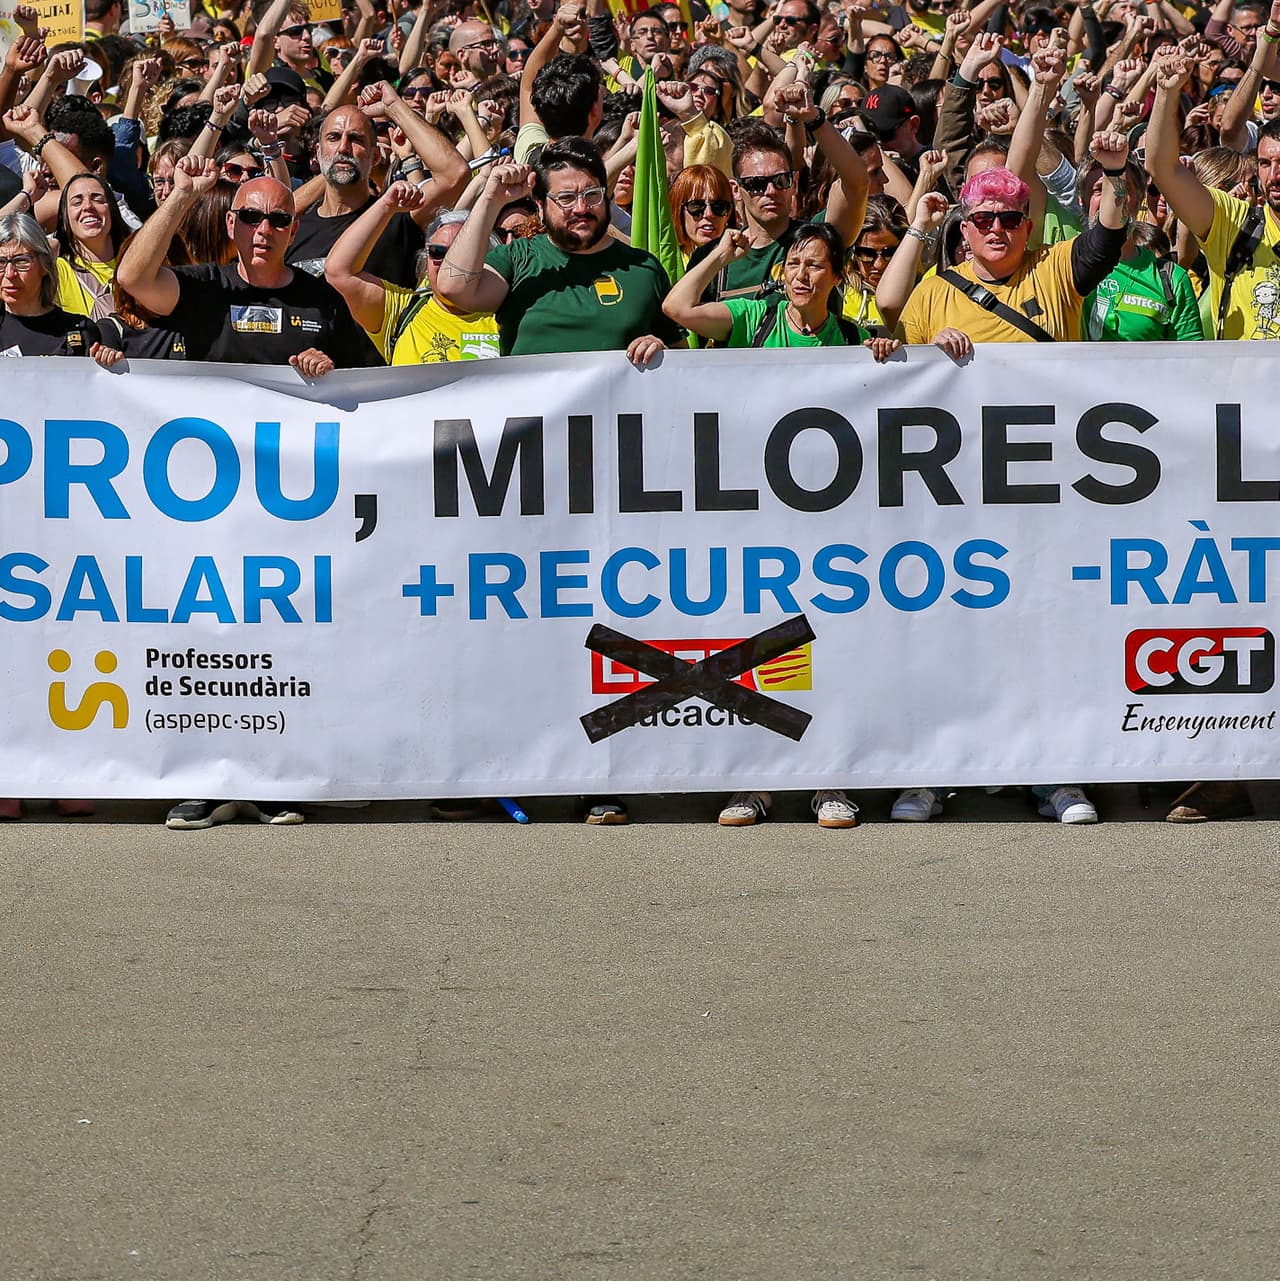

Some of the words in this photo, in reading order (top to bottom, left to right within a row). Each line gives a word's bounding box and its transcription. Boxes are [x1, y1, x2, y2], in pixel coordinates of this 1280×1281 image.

[434, 403, 1160, 518] MILLORES
[403, 539, 1010, 620] +RECURSOS
[146, 648, 273, 669] Professors
[1135, 638, 1266, 687] CGT
[145, 676, 173, 697] de
[179, 676, 311, 697] Secundària
[1121, 703, 1277, 739] Ensenyament
